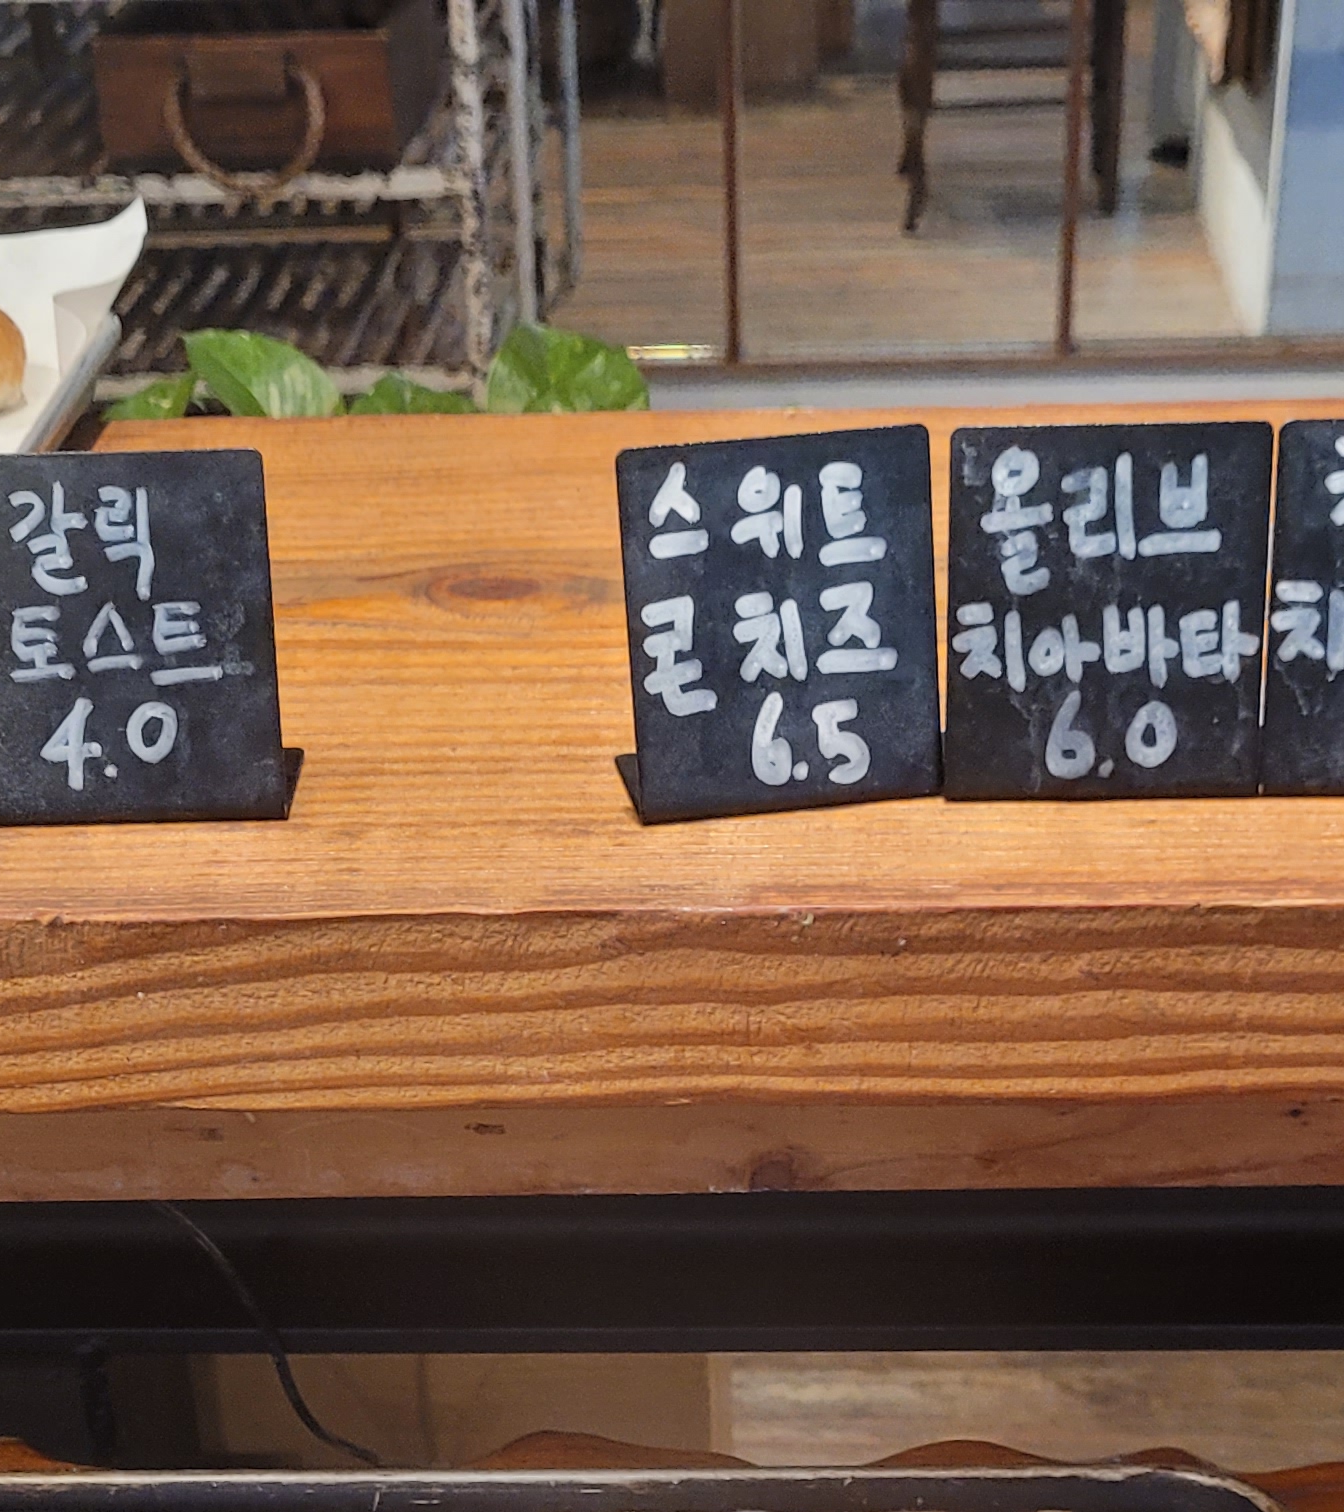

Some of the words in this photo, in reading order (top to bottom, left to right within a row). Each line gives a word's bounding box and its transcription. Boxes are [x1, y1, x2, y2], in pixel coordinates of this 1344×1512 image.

[6, 480, 155, 601] 갈릭
[648, 461, 888, 567] 스위트
[980, 445, 1222, 596] 올리브
[9, 600, 224, 686] 토스트
[951, 600, 1260, 693] 치아바타
[39, 696, 179, 791] 4.0
[751, 691, 871, 786] 6.5
[1044, 690, 1178, 780] 6.0
